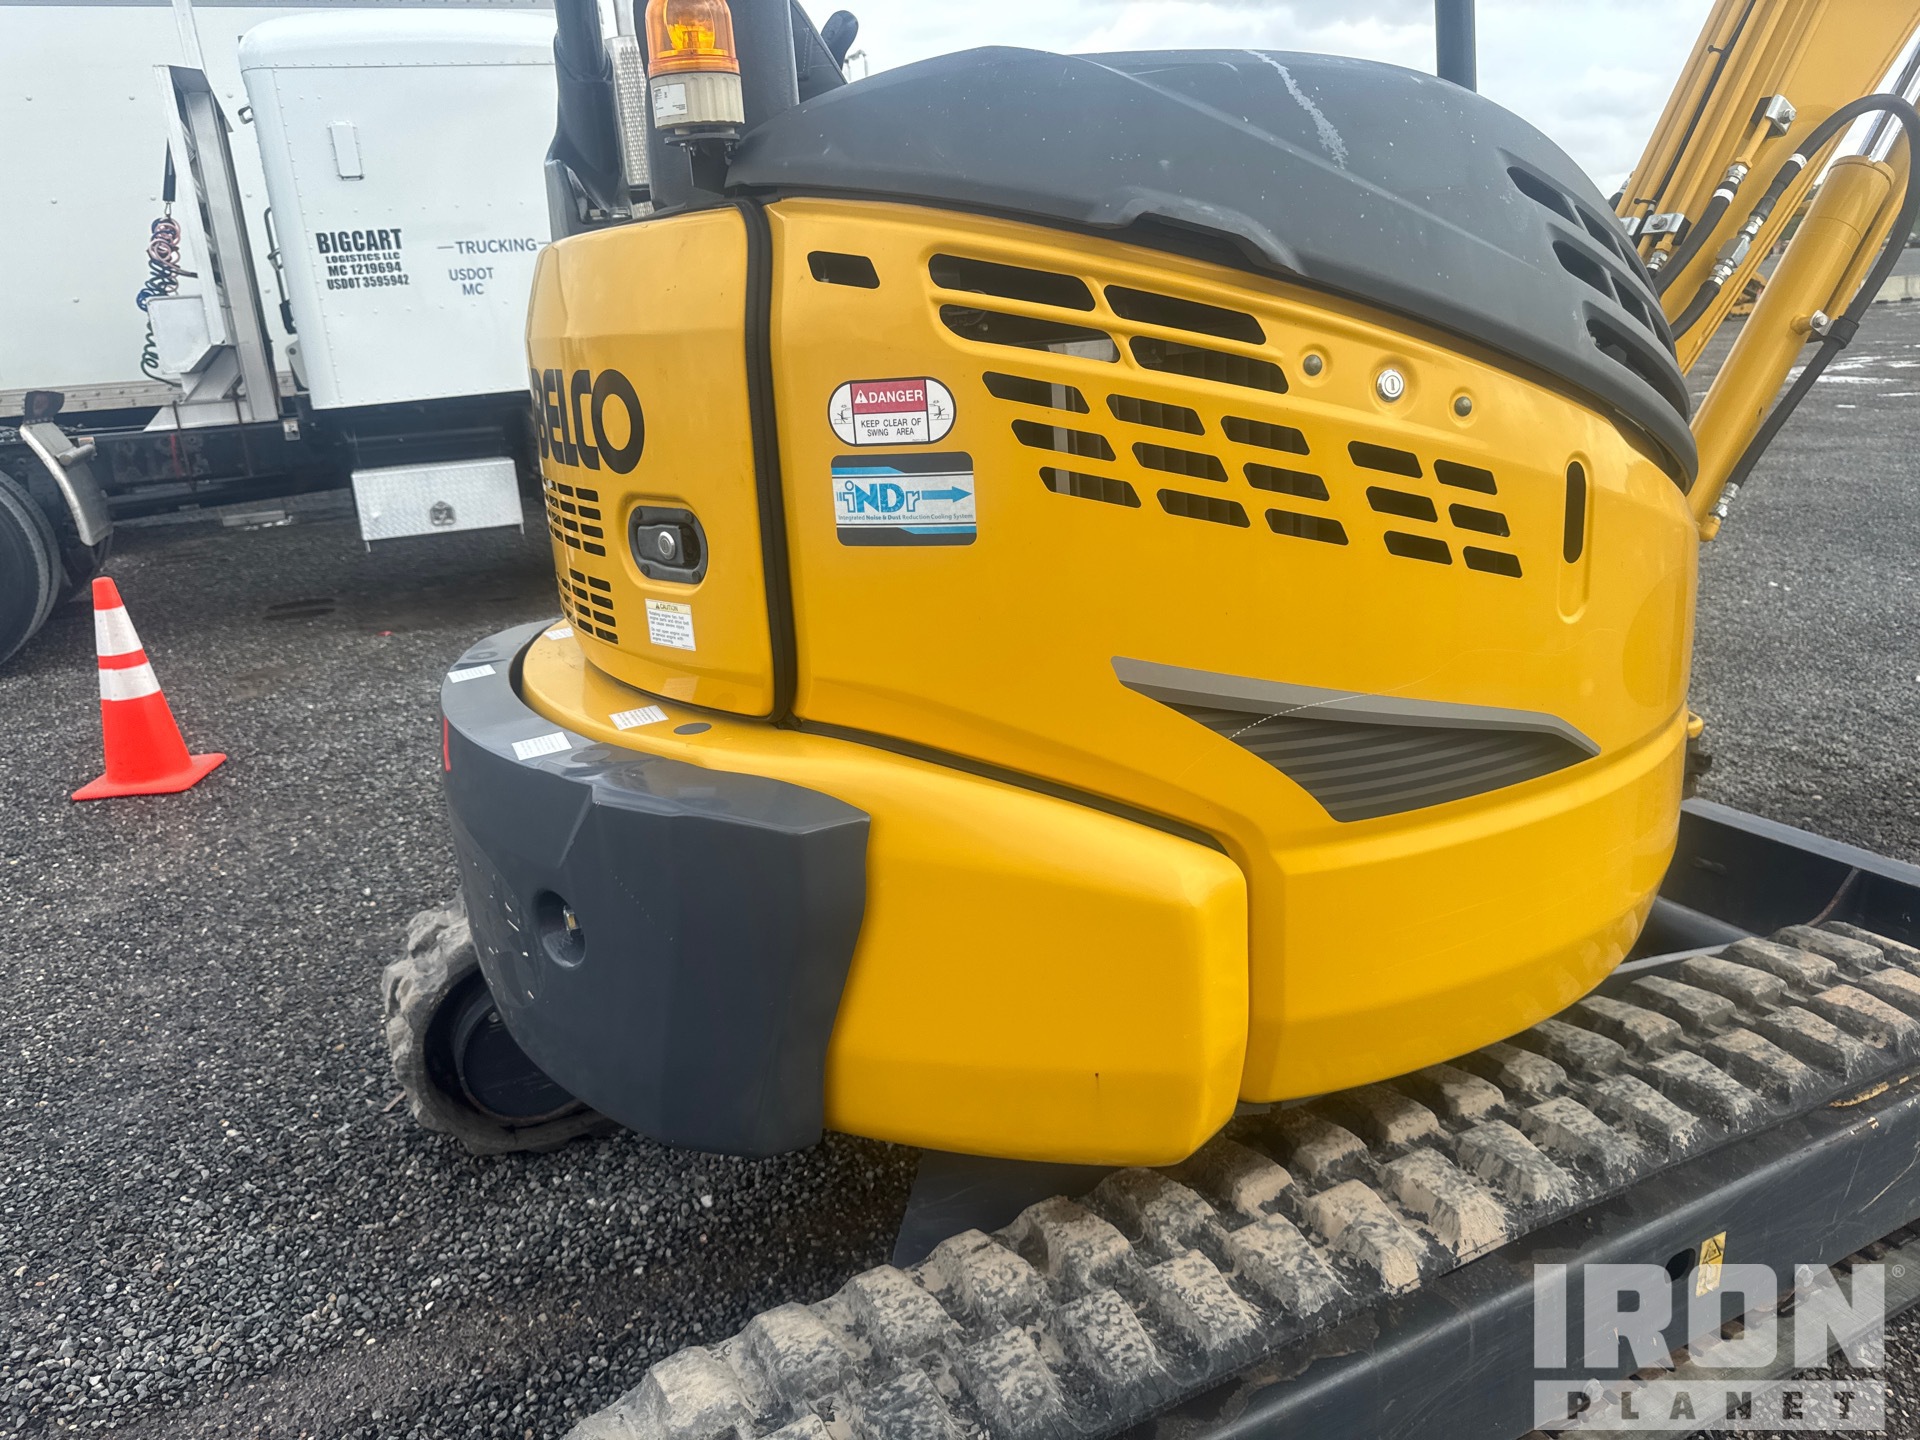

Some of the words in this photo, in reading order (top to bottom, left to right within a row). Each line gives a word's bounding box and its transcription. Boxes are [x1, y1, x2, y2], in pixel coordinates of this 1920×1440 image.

[315, 228, 402, 254] BIGCART
[454, 238, 538, 254] TRUCKING
[325, 253, 381, 264] LOGISTICS
[382, 252, 400, 261] LLC
[328, 264, 348, 277] MC
[349, 261, 402, 275] 1219694
[448, 267, 494, 281] USDOT
[326, 277, 361, 290] USDOT
[363, 274, 410, 288] 3595942
[462, 283, 485, 295] MC
[868, 389, 924, 404] DANGER
[860, 419, 880, 428] KEEP
[883, 418, 908, 427] CLEAR
[911, 417, 922, 426] OF
[867, 428, 889, 437] SWING
[896, 427, 914, 436] AREA
[931, 513, 952, 521] Cooling
[953, 513, 973, 521] System
